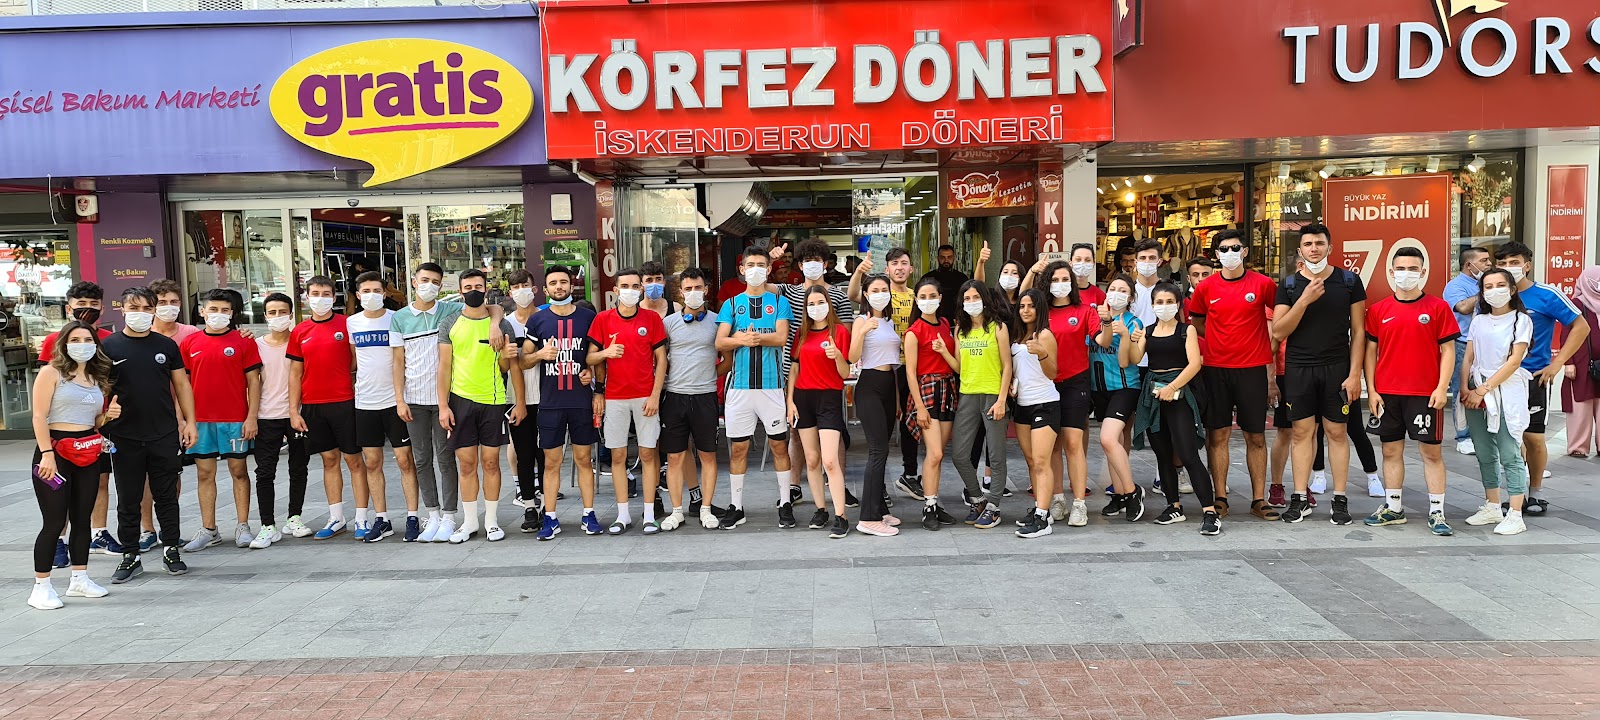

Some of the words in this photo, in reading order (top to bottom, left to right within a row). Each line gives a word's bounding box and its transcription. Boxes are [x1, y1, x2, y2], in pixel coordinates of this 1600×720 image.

[548, 38, 838, 113] KÖRFEZ
[852, 29, 1107, 105] DÖNER
[62, 88, 149, 112] Bakım
[155, 84, 262, 112] Marketi
[297, 52, 503, 138] gratis
[594, 119, 871, 156] İSKENDERUN
[901, 104, 1063, 147] DÖNERİ
[959, 181, 994, 199] Döner
[1344, 193, 1370, 202] BÜYÜK
[1371, 193, 1387, 201] YAZ
[1344, 200, 1430, 222] İNDİRİMİ
[1550, 206, 1583, 216] İNDİRİMİ
[122, 237, 154, 245] Kozmetik
[1551, 255, 1574, 269] 19,99
[113, 269, 125, 278] Saç
[969, 348, 983, 356] 1972
[1413, 414, 1432, 428] 48
[230, 438, 246, 452] 17
